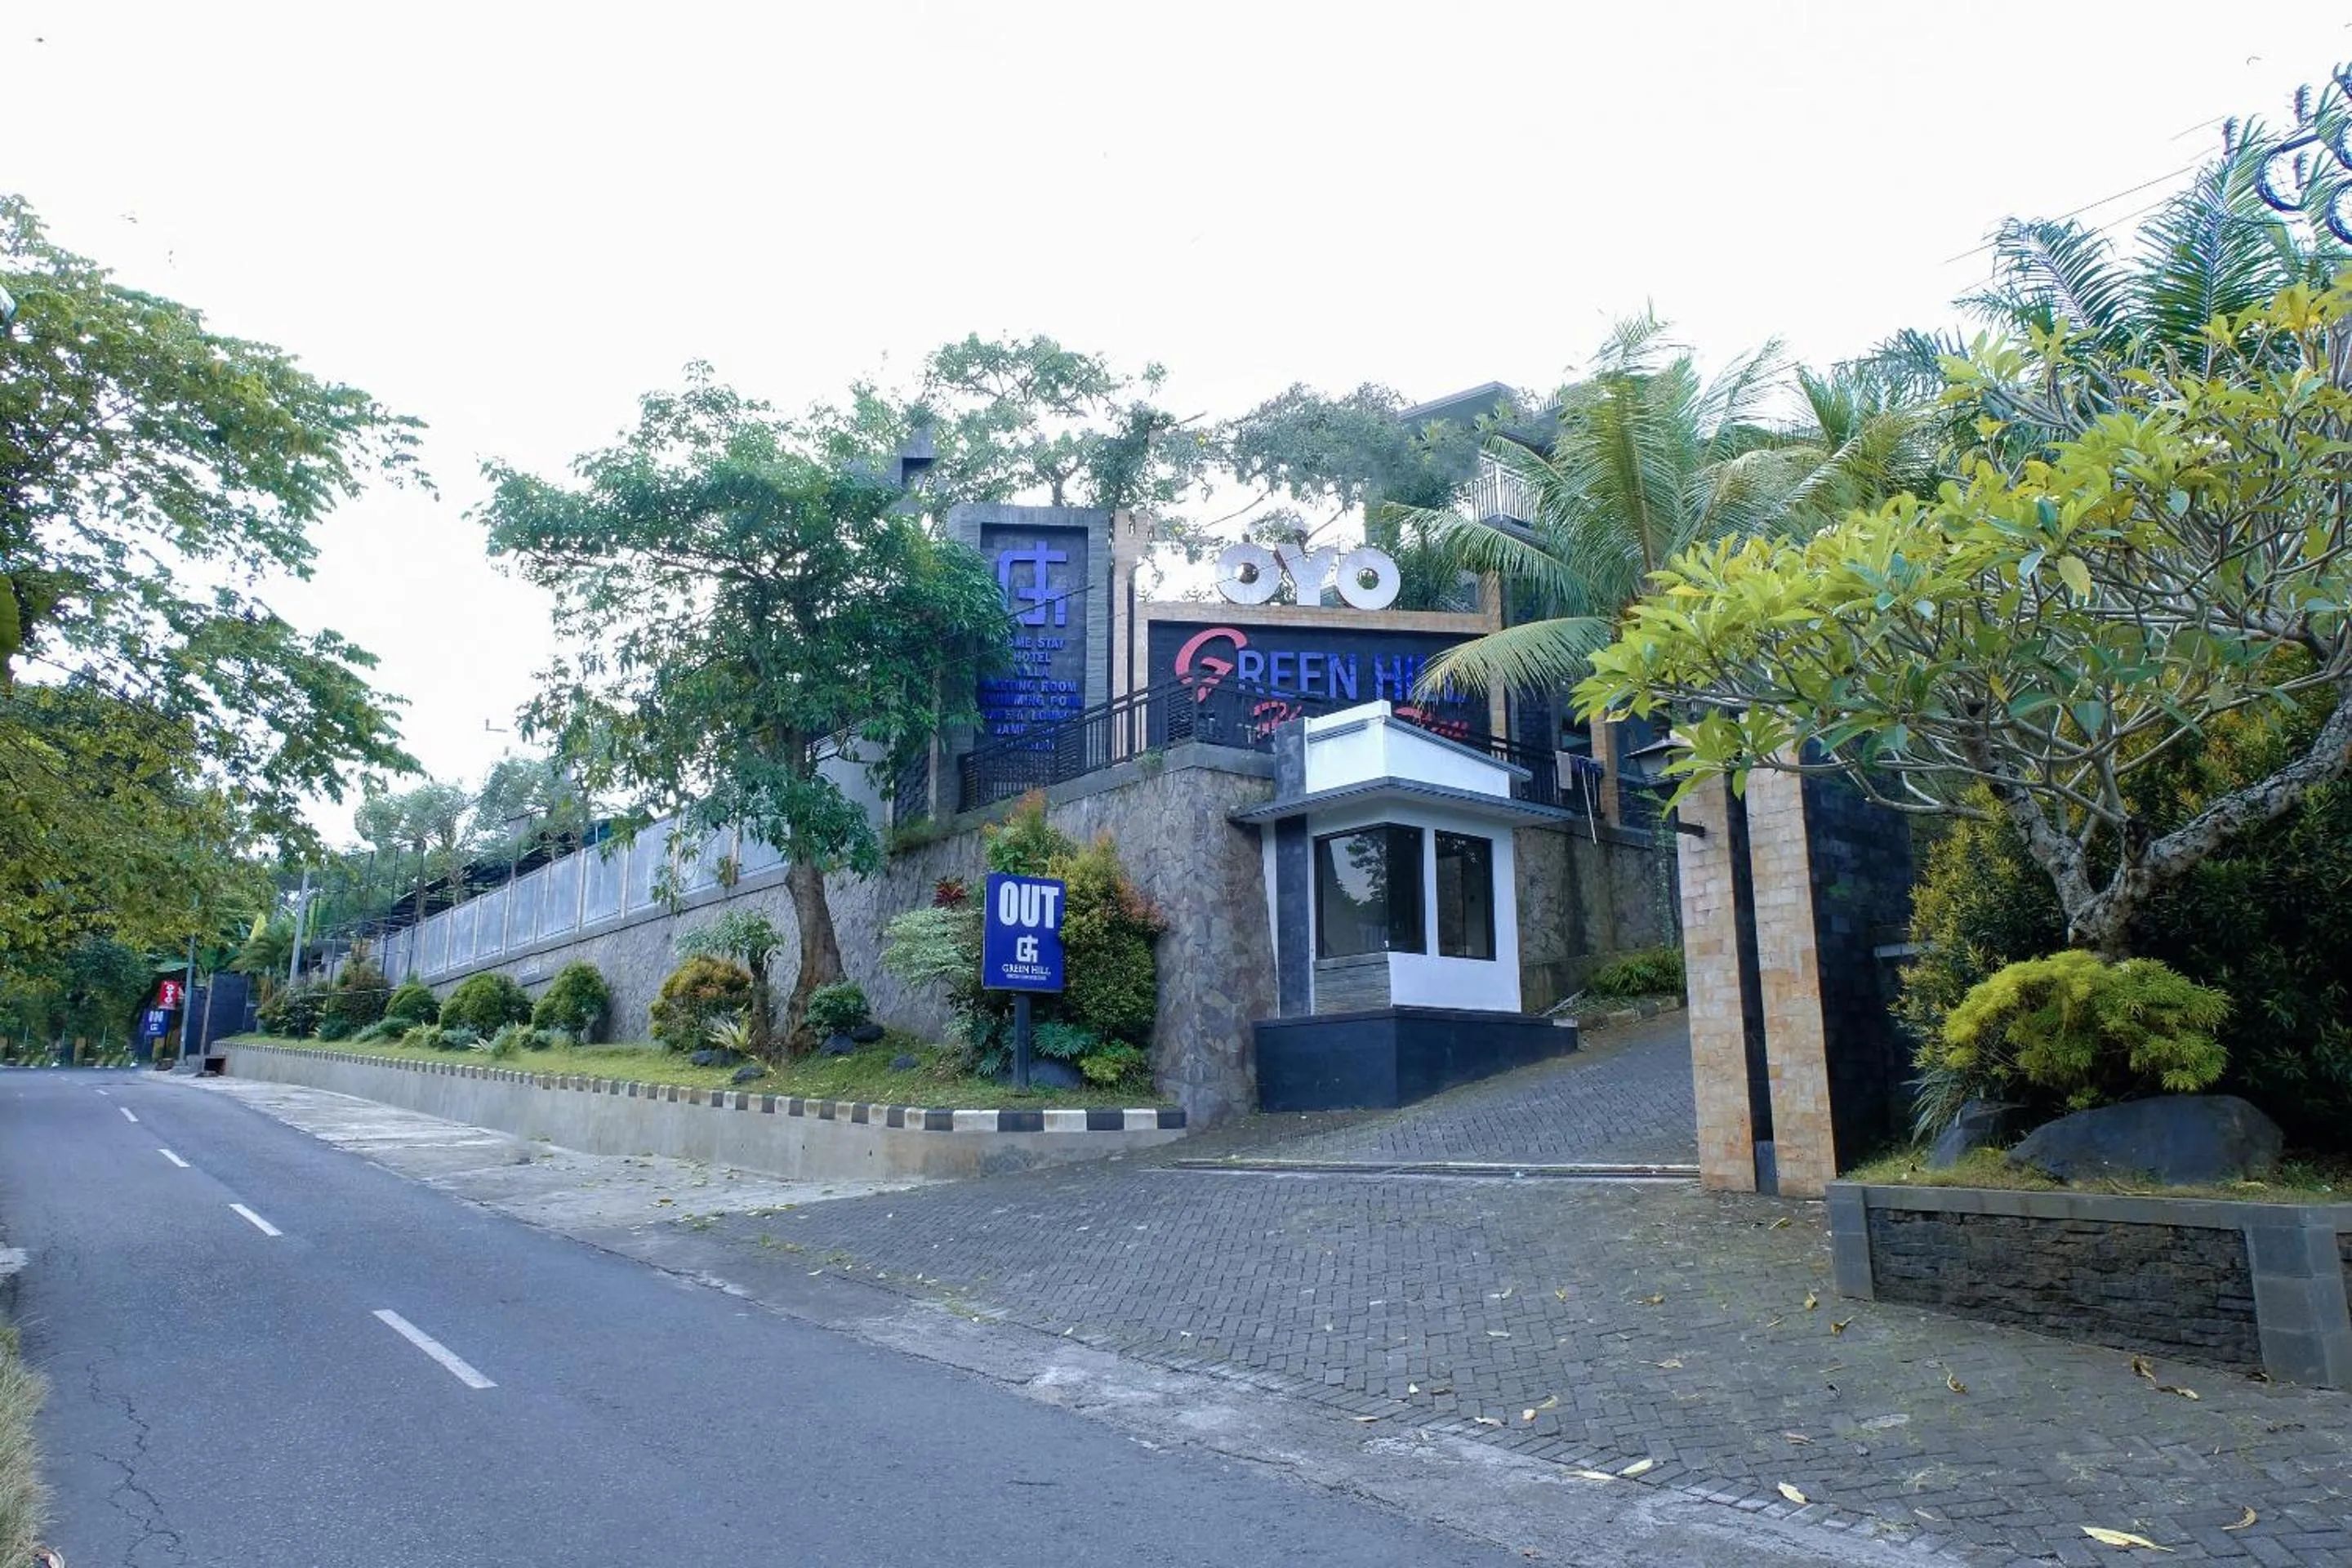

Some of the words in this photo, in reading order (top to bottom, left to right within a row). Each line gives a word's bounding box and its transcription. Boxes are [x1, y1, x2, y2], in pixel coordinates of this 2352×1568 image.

[1215, 542, 1401, 611] OYO
[1014, 651, 1052, 662] HOTEL
[1037, 637, 1066, 648] STAY
[1174, 627, 1357, 702] GREEN
[999, 881, 1060, 929] OUT
[1001, 964, 1029, 973] GREEN
